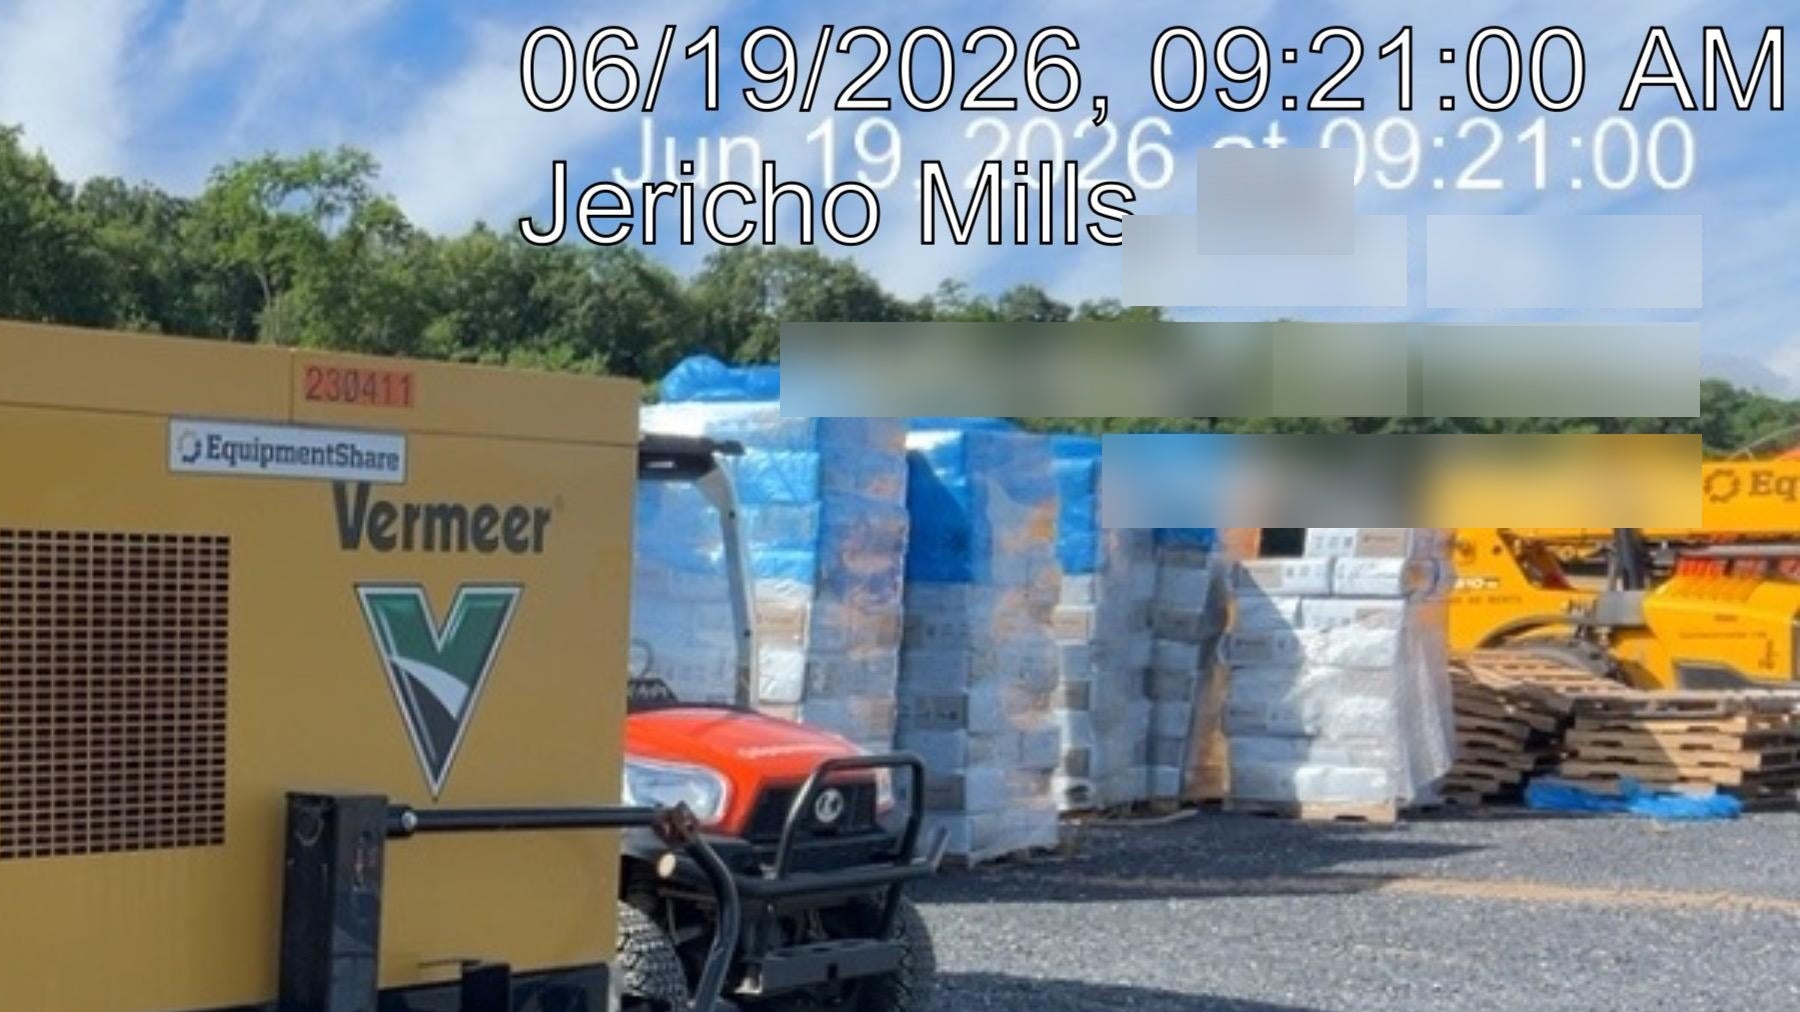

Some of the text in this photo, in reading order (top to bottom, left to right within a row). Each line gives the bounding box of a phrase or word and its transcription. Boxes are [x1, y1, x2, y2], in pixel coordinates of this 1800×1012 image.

[304, 365, 413, 407] 230411
[205, 433, 400, 471] EquipmentShare
[332, 480, 552, 554] Vermeer
